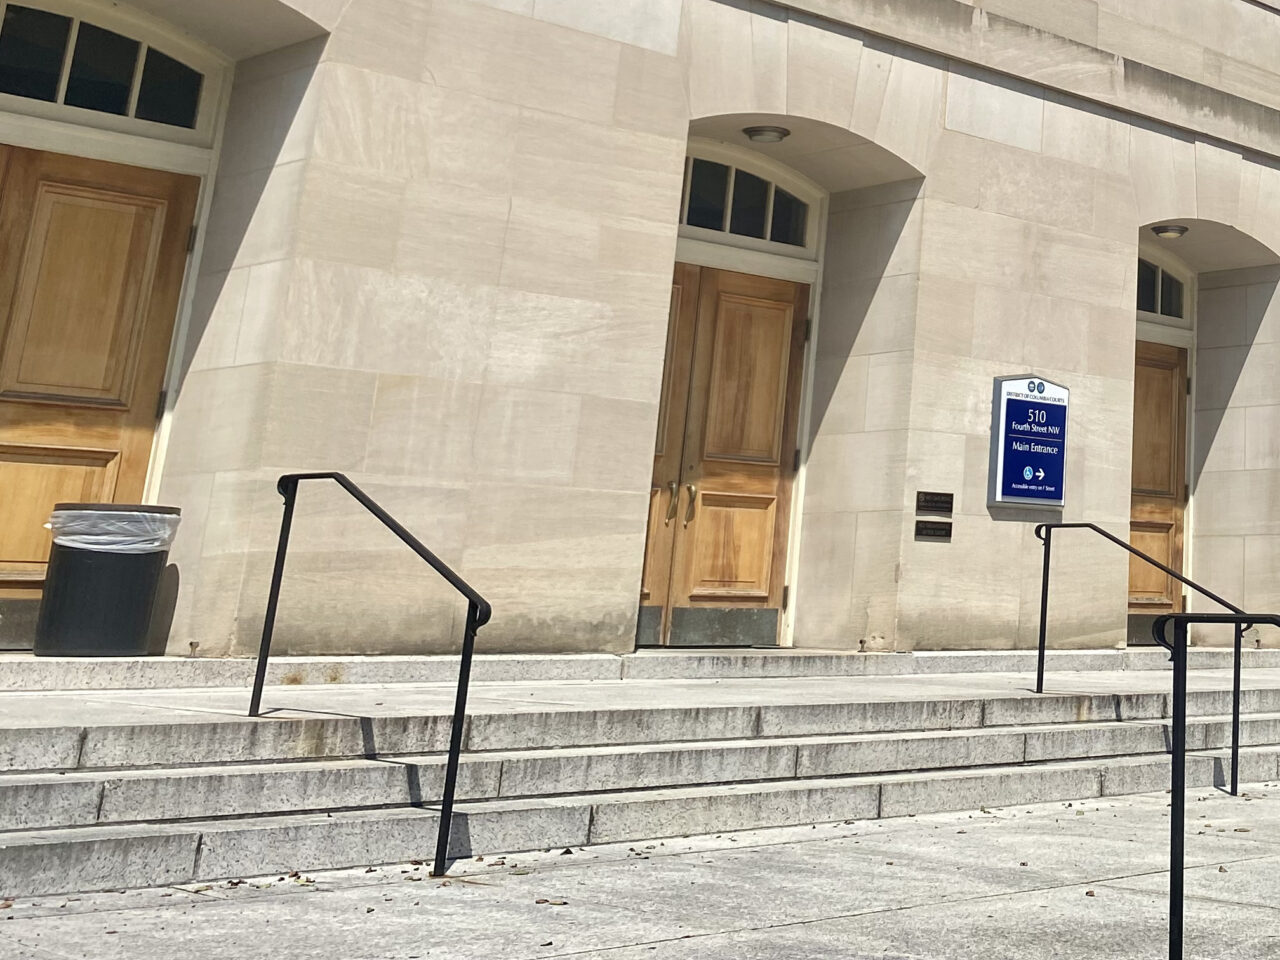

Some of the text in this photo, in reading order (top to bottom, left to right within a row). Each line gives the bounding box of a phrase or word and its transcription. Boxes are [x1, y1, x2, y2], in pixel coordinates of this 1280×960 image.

[1027, 409, 1046, 423] 510
[1012, 421, 1060, 435] Fourth Street NW
[1012, 441, 1058, 454] Main Entrance
